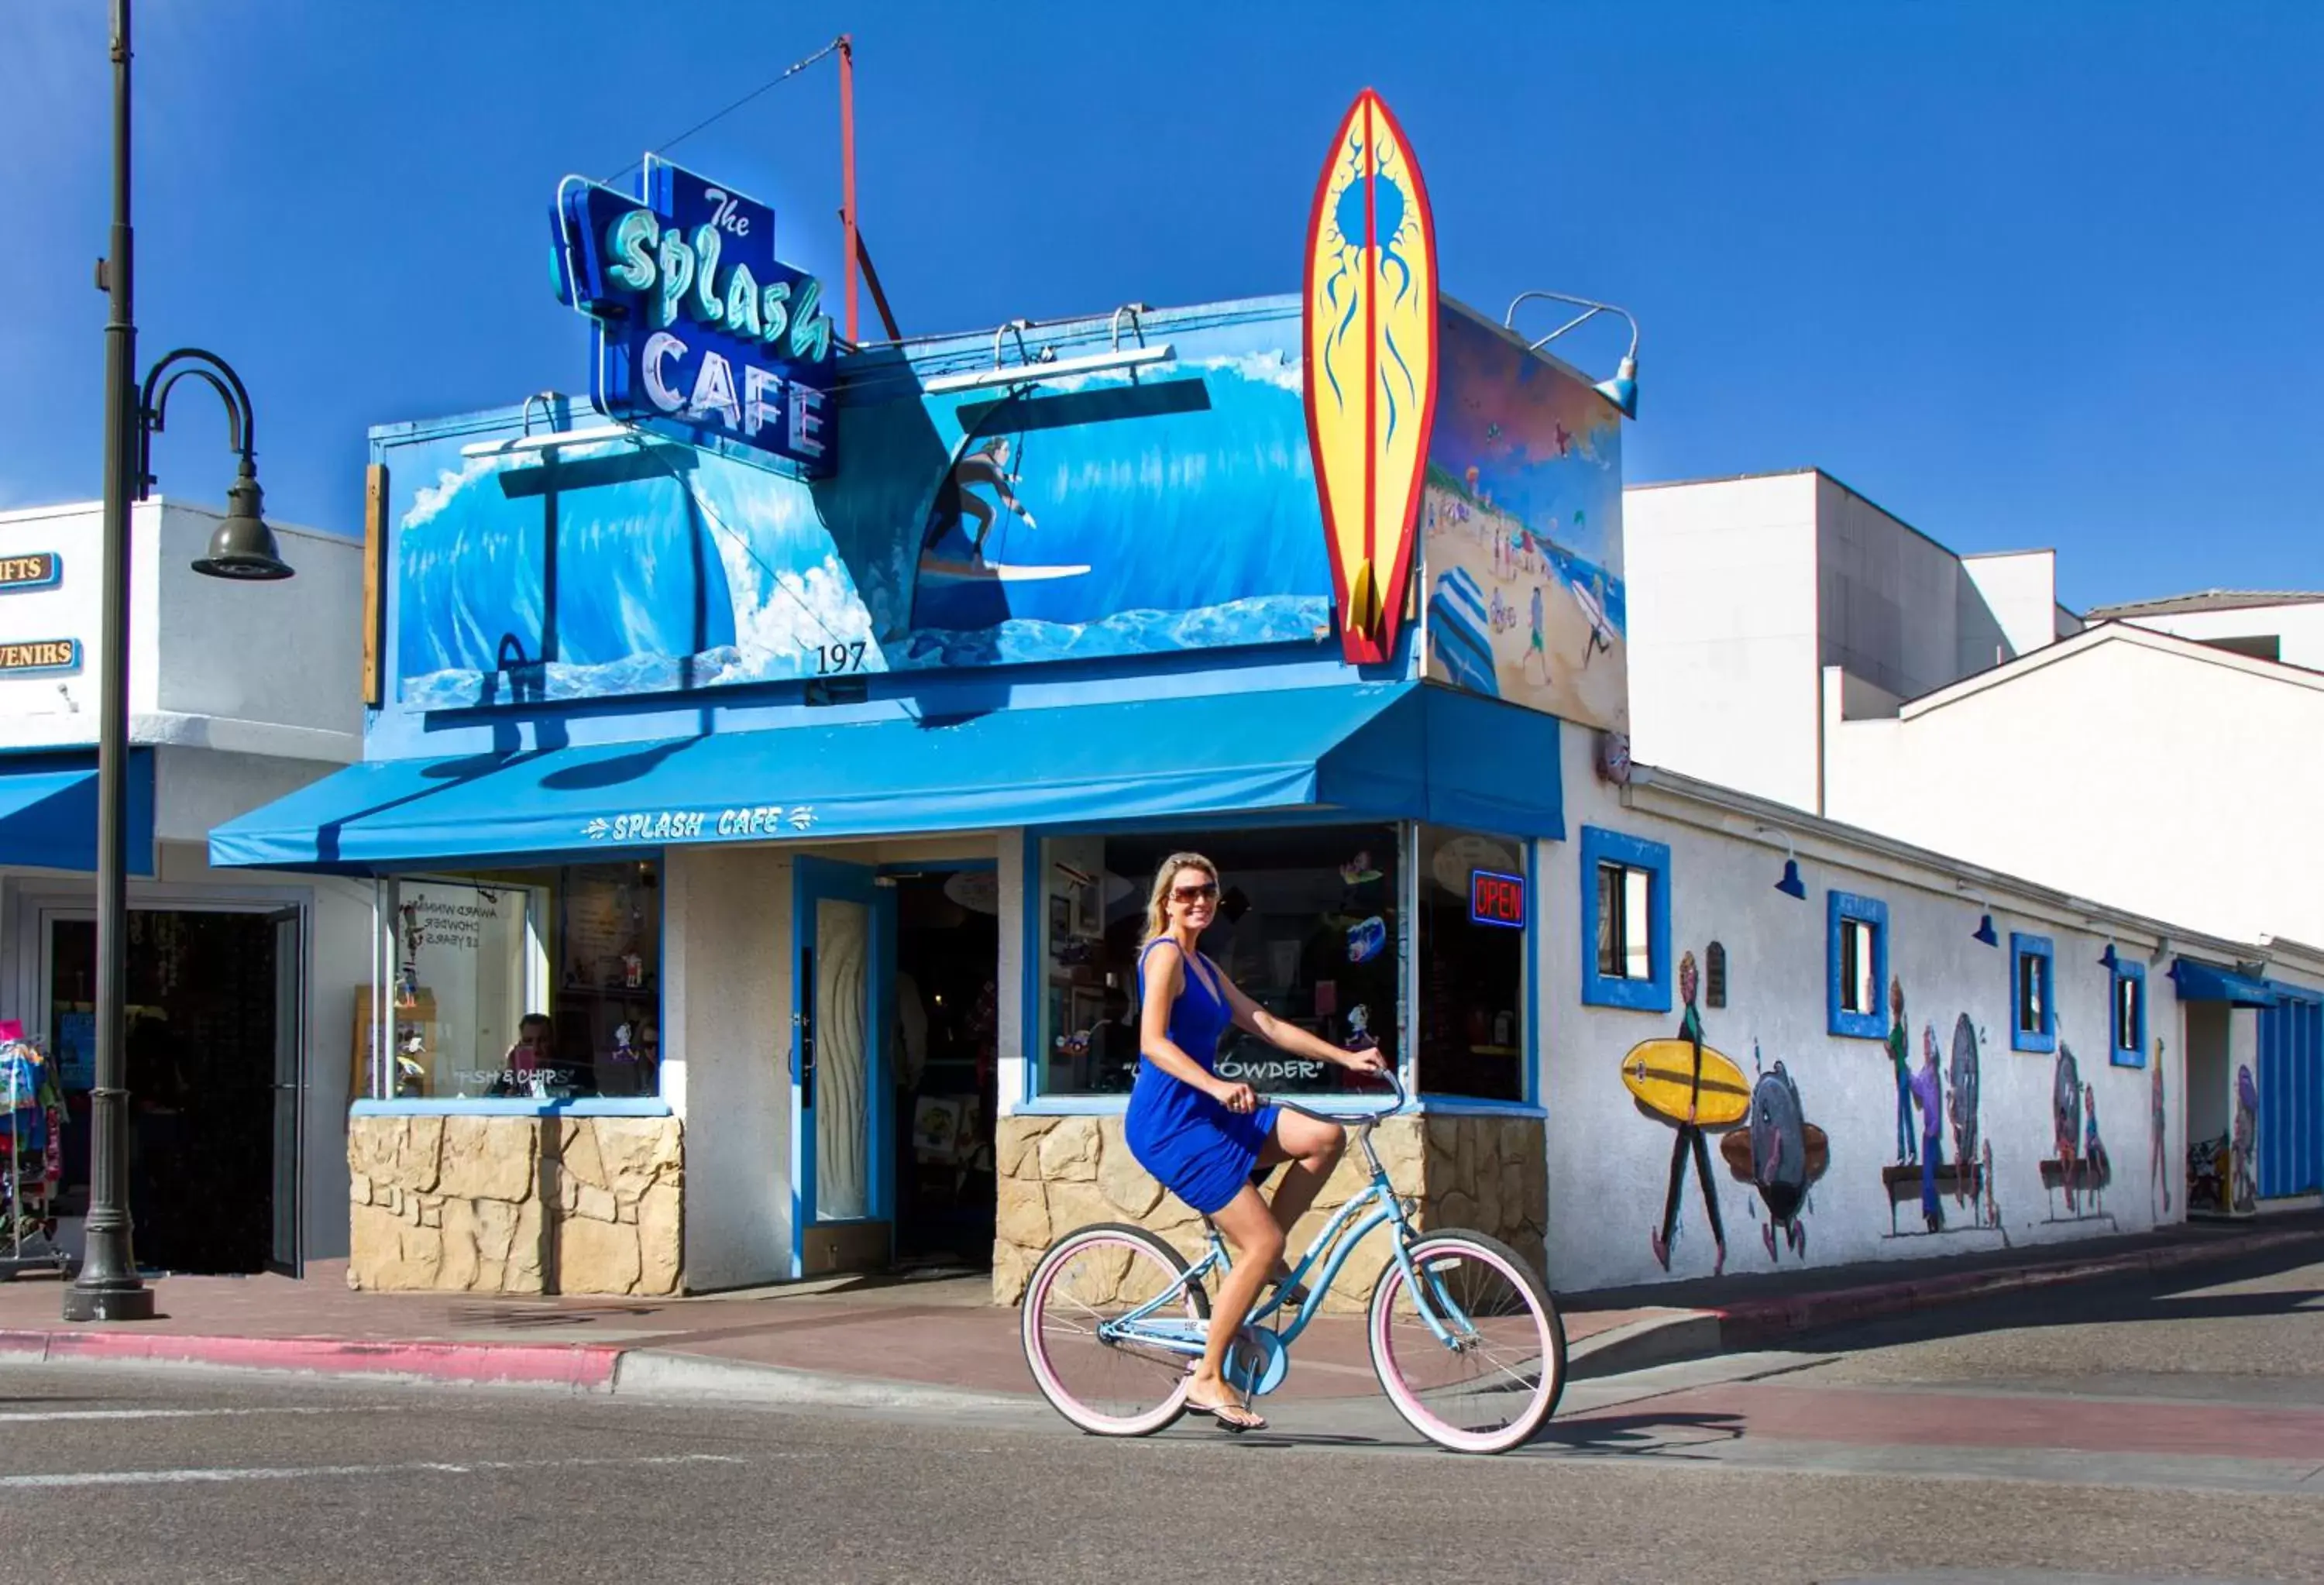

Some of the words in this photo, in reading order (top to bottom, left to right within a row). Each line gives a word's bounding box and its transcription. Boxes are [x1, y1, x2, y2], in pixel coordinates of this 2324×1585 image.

[704, 188, 750, 237] The
[607, 208, 831, 364] Splash
[641, 331, 827, 459] CAFE
[817, 641, 867, 675] 197
[613, 811, 706, 841] SPLASH
[717, 806, 783, 835] CAFE
[1476, 877, 1521, 919] OPEN
